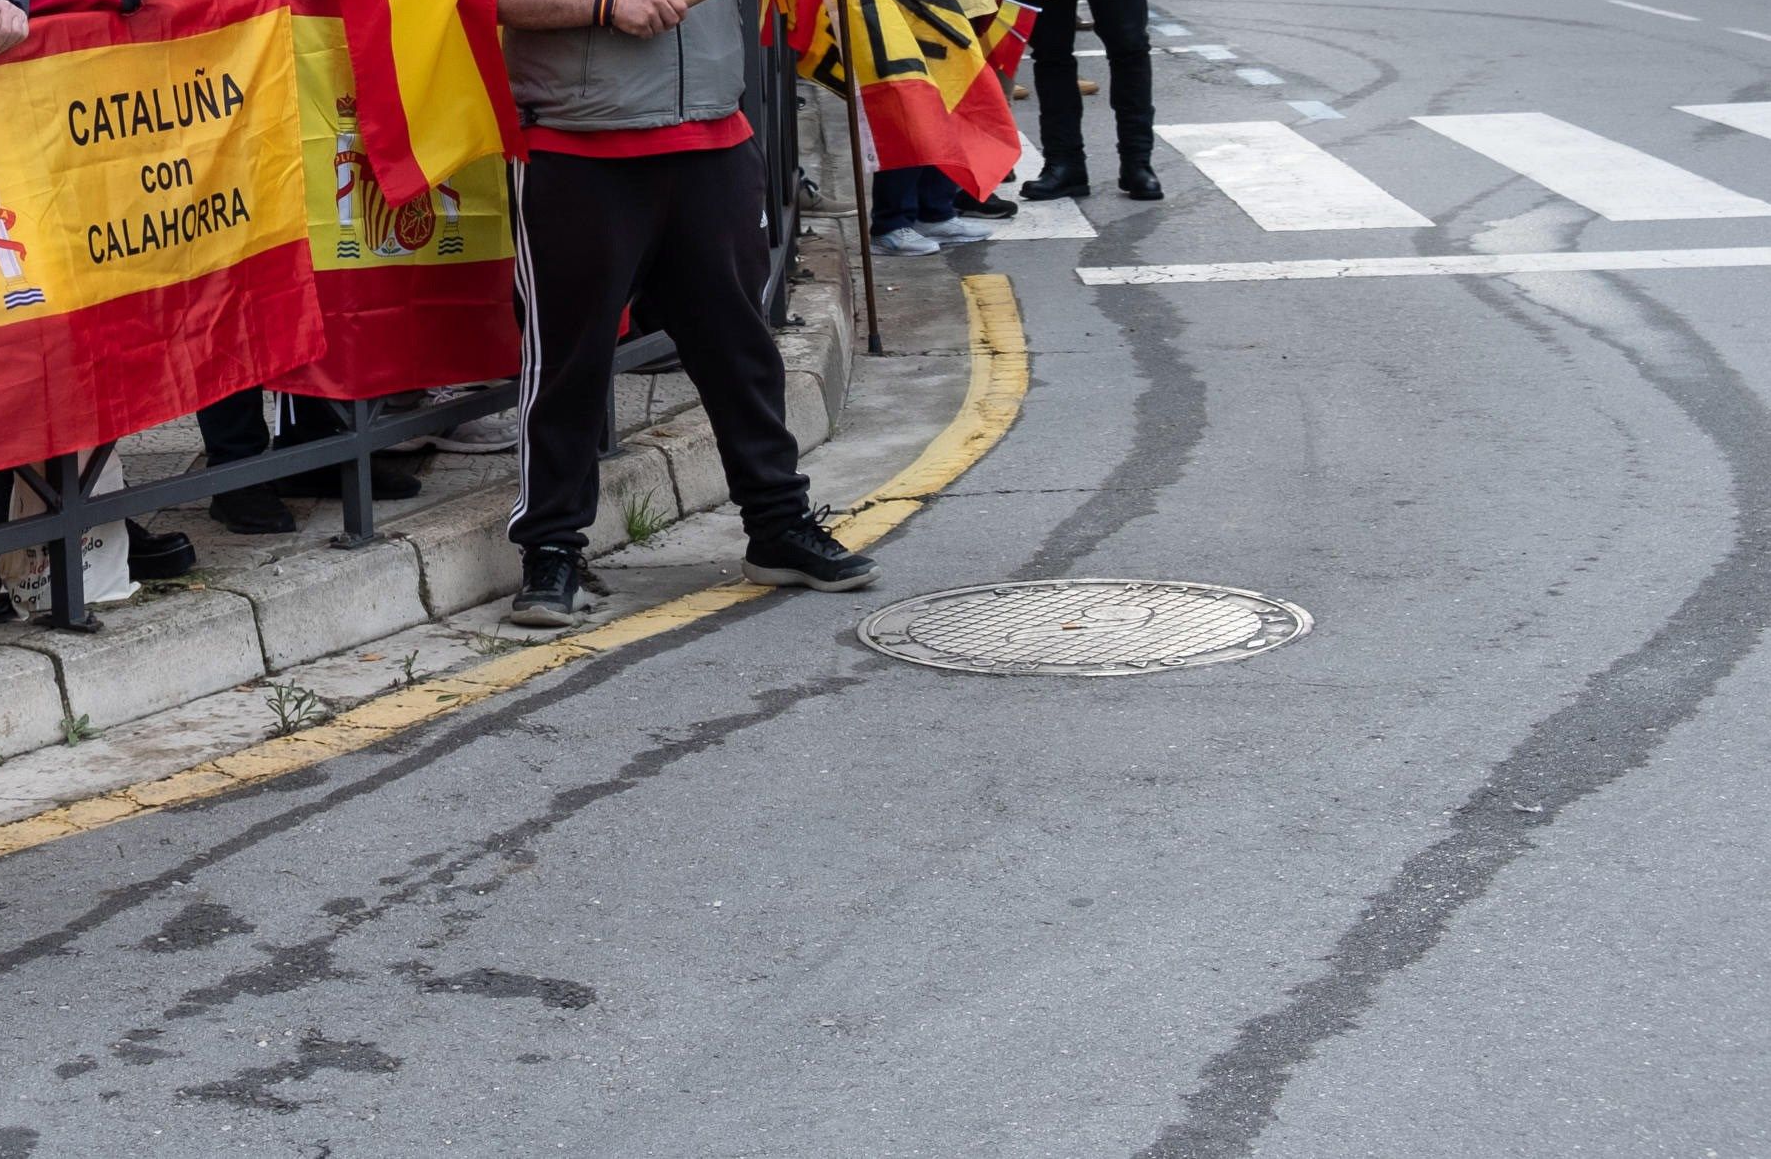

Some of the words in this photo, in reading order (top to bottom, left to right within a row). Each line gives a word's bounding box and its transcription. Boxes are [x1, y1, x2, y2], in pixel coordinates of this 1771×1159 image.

[68, 67, 244, 146] CATALUÑA
[141, 157, 193, 193] con
[88, 187, 250, 264] CALAHORRA
